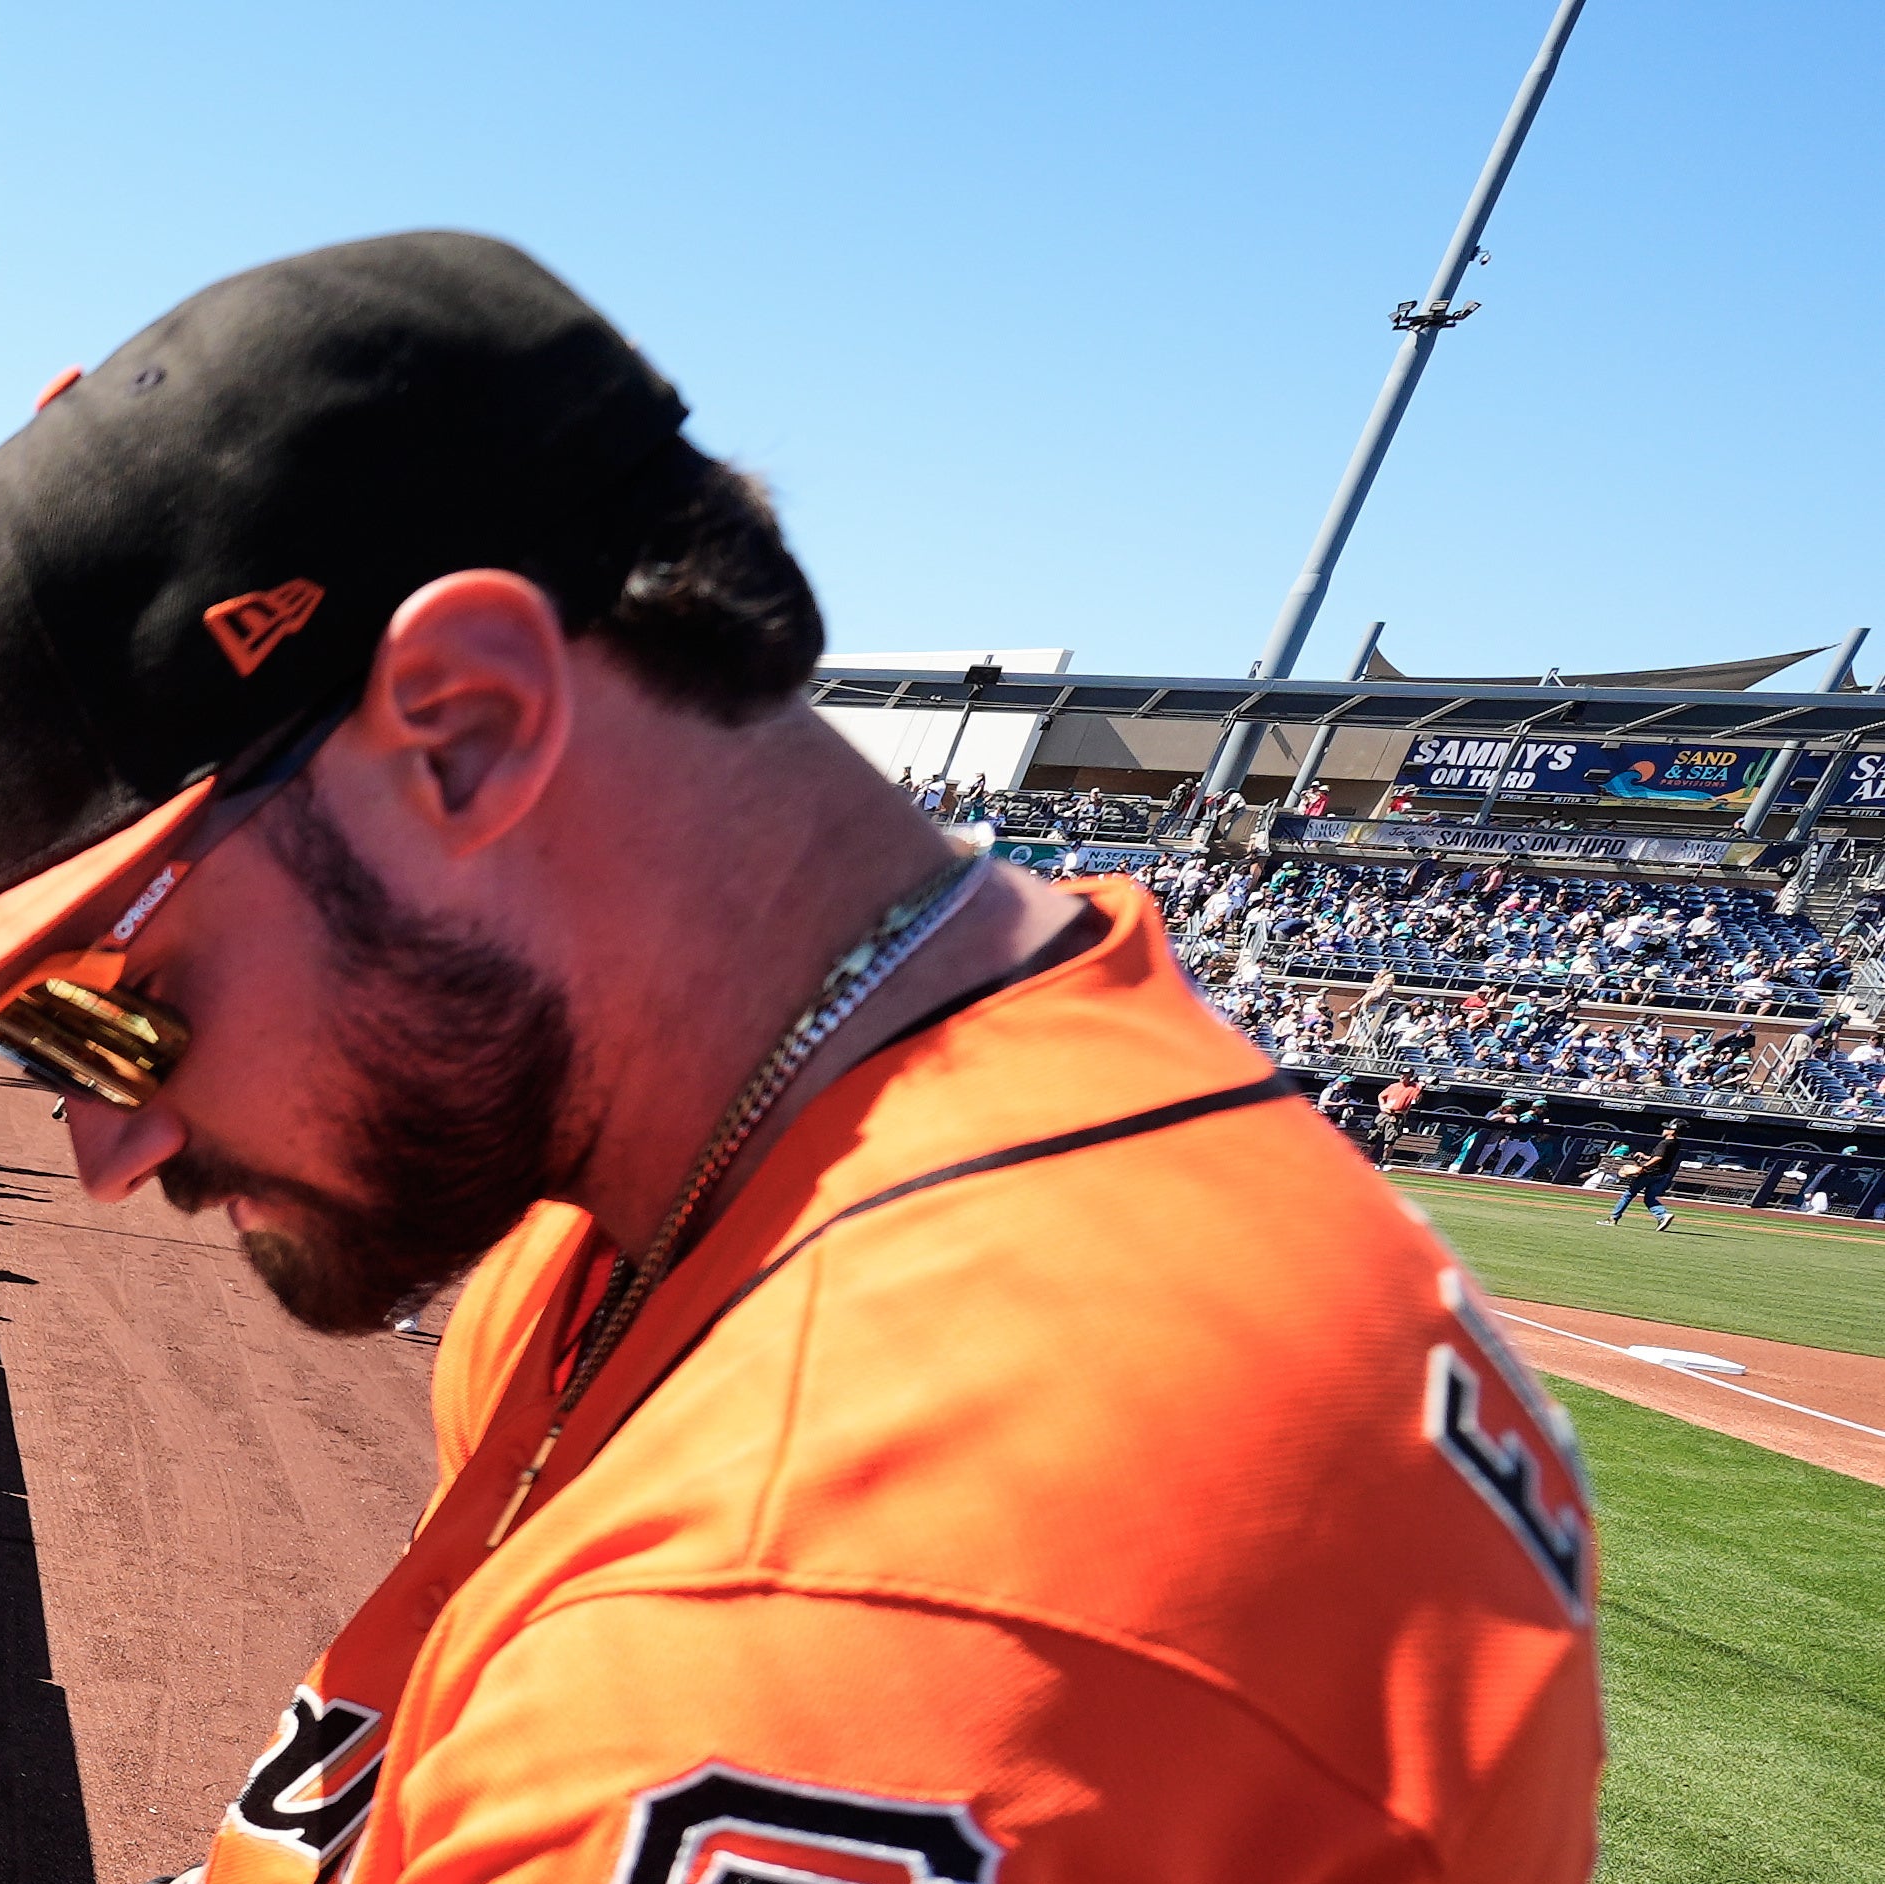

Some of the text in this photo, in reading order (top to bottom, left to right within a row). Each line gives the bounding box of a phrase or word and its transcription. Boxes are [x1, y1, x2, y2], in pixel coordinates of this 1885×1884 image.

[1414, 739, 1577, 771] SAMMY'S
[1674, 750, 1738, 766] SAND
[1430, 767, 1537, 789] ON THRD
[1659, 778, 1728, 788] PROVISIONS
[1664, 766, 1729, 782] & SEA
[1388, 827, 1415, 837] Join
[1436, 830, 1627, 856] SAMMY'S ON THIRD
[113, 866, 176, 940] OAKLEY
